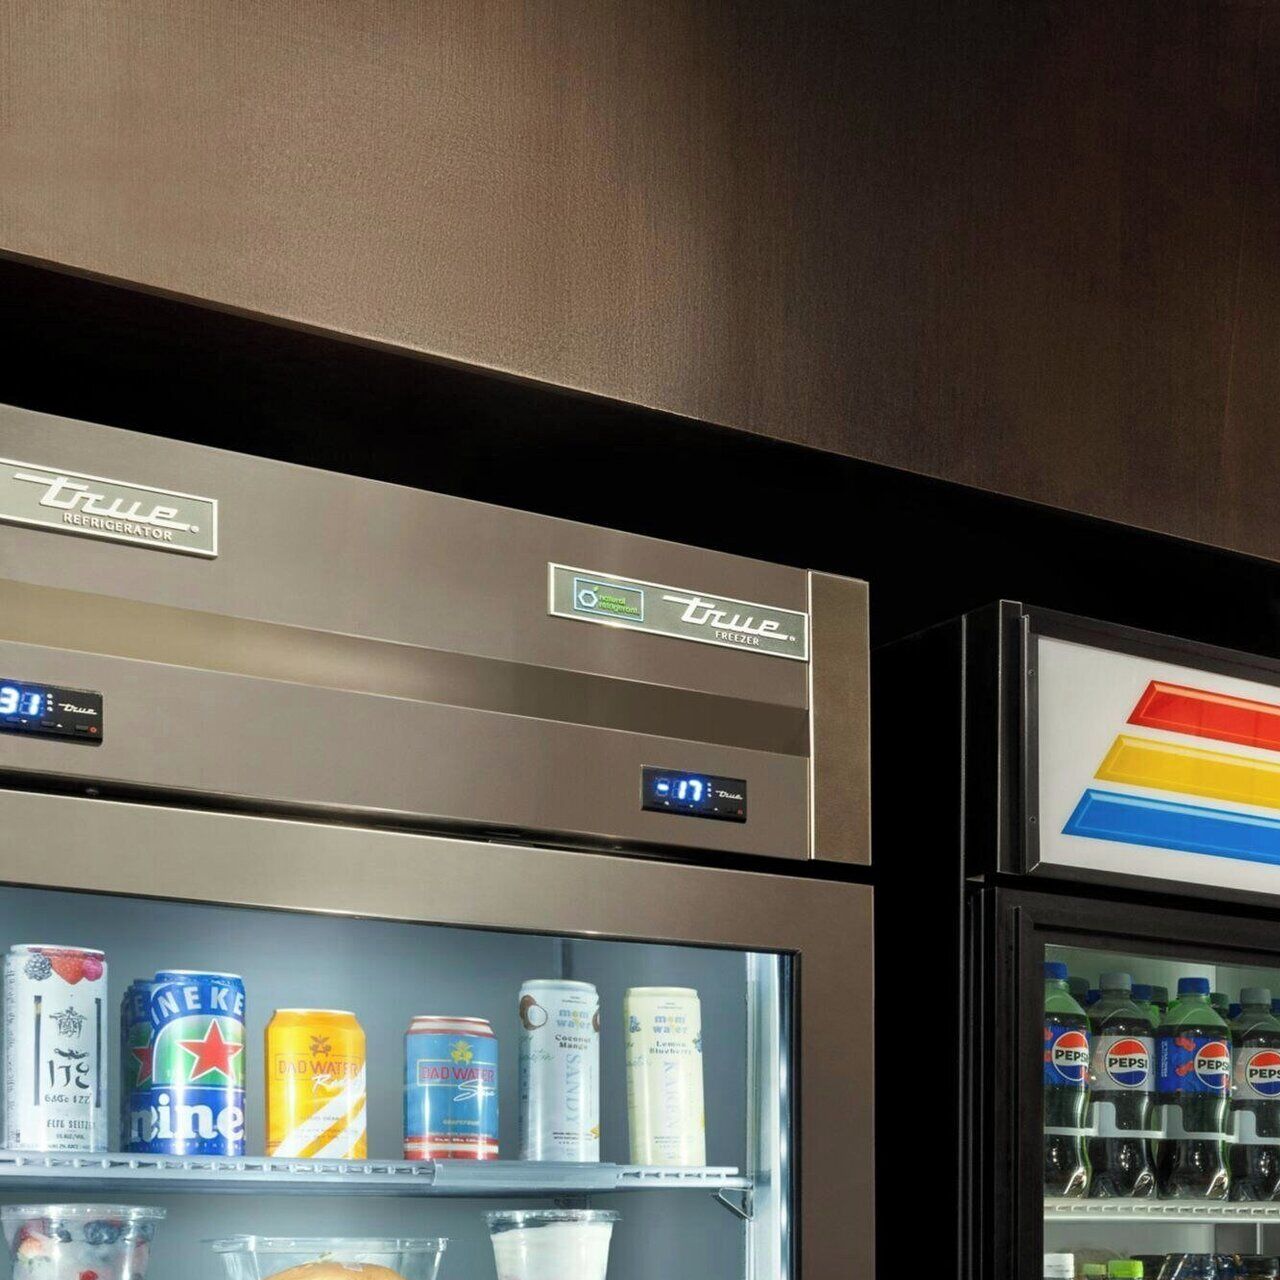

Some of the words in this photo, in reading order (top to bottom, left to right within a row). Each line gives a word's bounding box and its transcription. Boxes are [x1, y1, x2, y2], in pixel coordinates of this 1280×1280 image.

[63, 512, 173, 541] REFRIGERATOR
[715, 630, 759, 646] FREEZER
[1109, 1058, 1148, 1068] PEPSI
[419, 1065, 451, 1081] DAD
